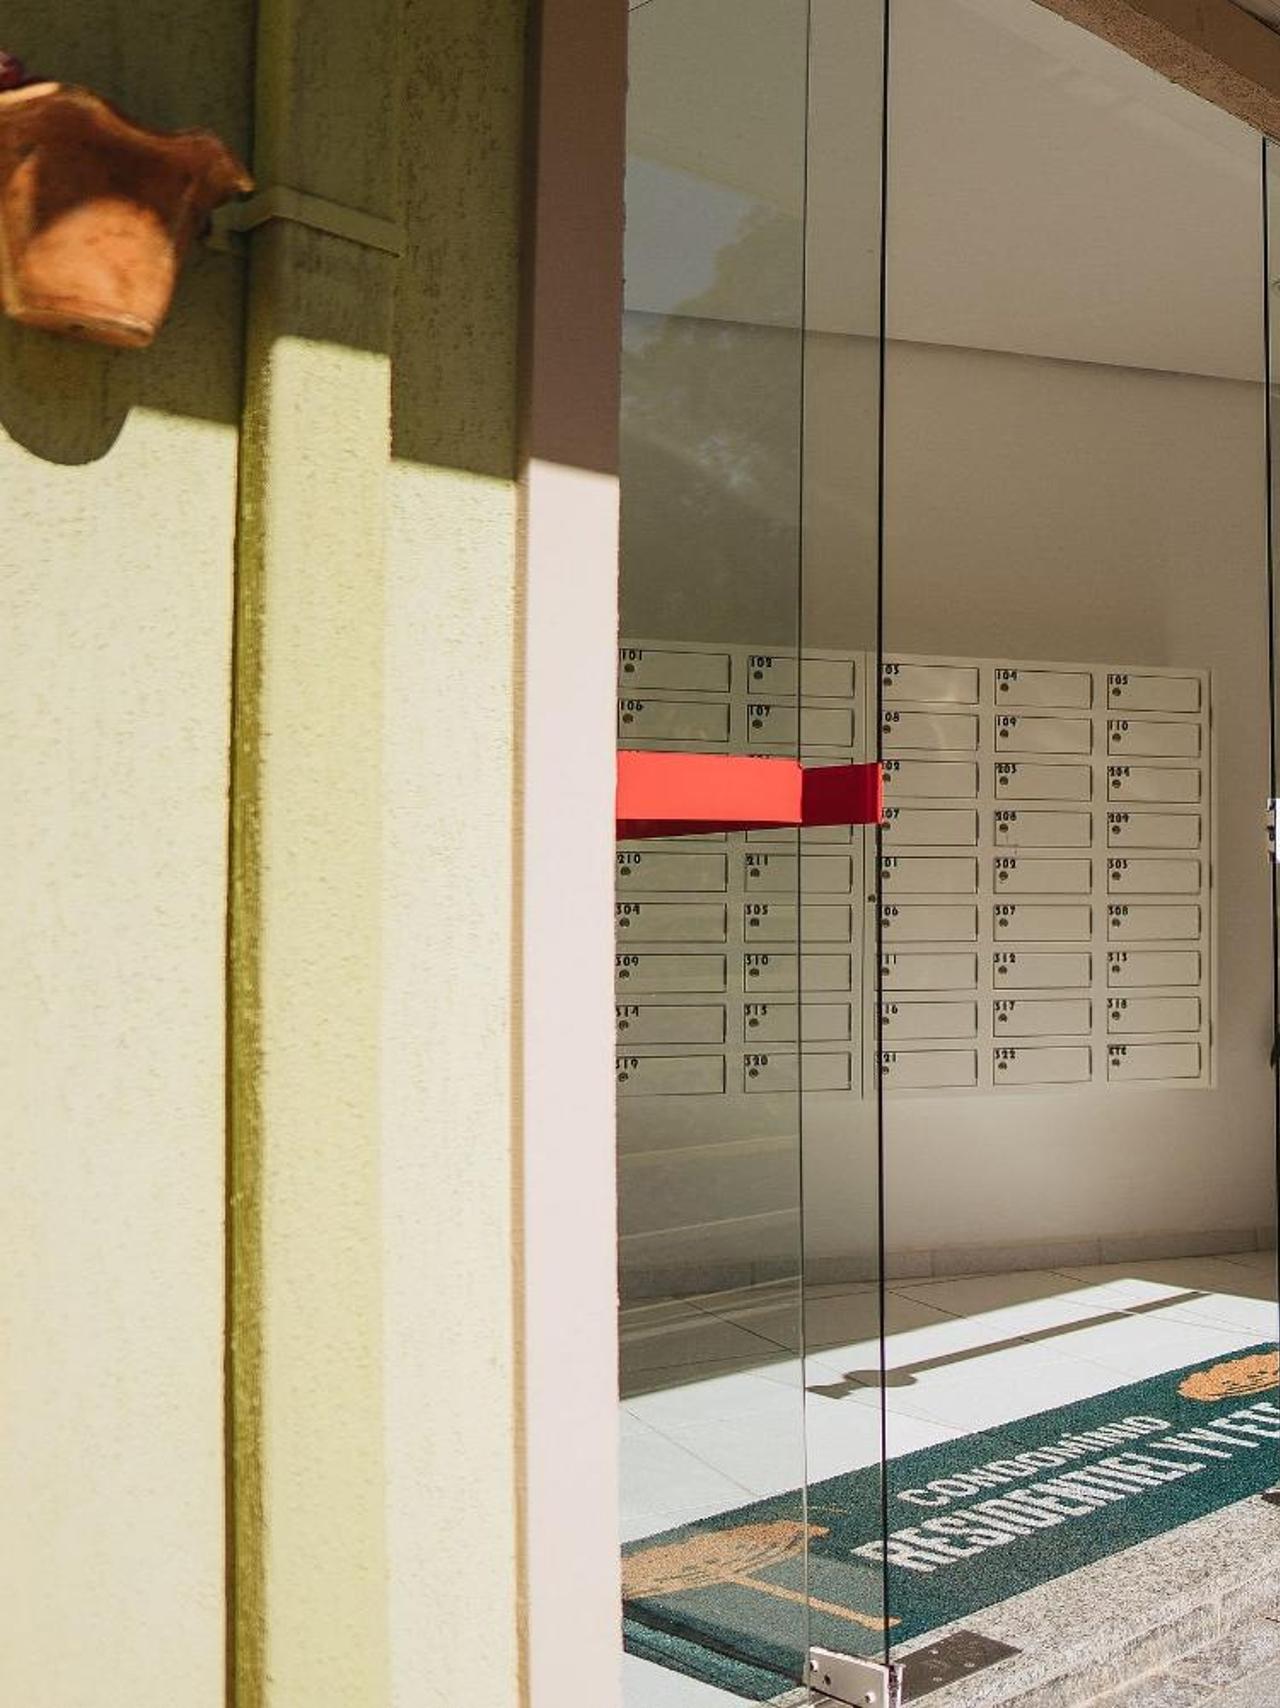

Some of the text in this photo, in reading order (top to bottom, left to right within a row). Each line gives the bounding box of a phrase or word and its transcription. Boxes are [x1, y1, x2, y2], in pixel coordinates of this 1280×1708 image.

[622, 649, 642, 661] 101
[750, 656, 772, 668] 102
[885, 664, 899, 675] 03
[1109, 674, 1128, 685] 105
[620, 700, 643, 711] 106
[750, 705, 770, 717] 107
[885, 712, 900, 722] 08
[997, 717, 1017, 728] 109
[1109, 720, 1128, 731] 110
[617, 853, 641, 864] 210
[746, 854, 768, 866] 211
[884, 857, 897, 868] 01
[1108, 859, 1128, 869] 303
[616, 904, 640, 915] 304
[746, 904, 768, 915] 305
[884, 906, 899, 916] 06
[995, 905, 1016, 915] 307
[616, 956, 639, 966] 309
[746, 955, 768, 965] 310
[885, 954, 897, 965] 11
[994, 953, 1016, 963] 312
[1108, 952, 1127, 962] 313
[885, 1004, 898, 1014] 16
[1107, 999, 1127, 1009] 318
[745, 1005, 767, 1015] 315
[745, 1055, 768, 1065] 320
[883, 1053, 896, 1063] 21
[897, 1415, 1171, 1506] CONDOMÍNIO
[850, 1452, 1207, 1573] RESIDENTIEL
